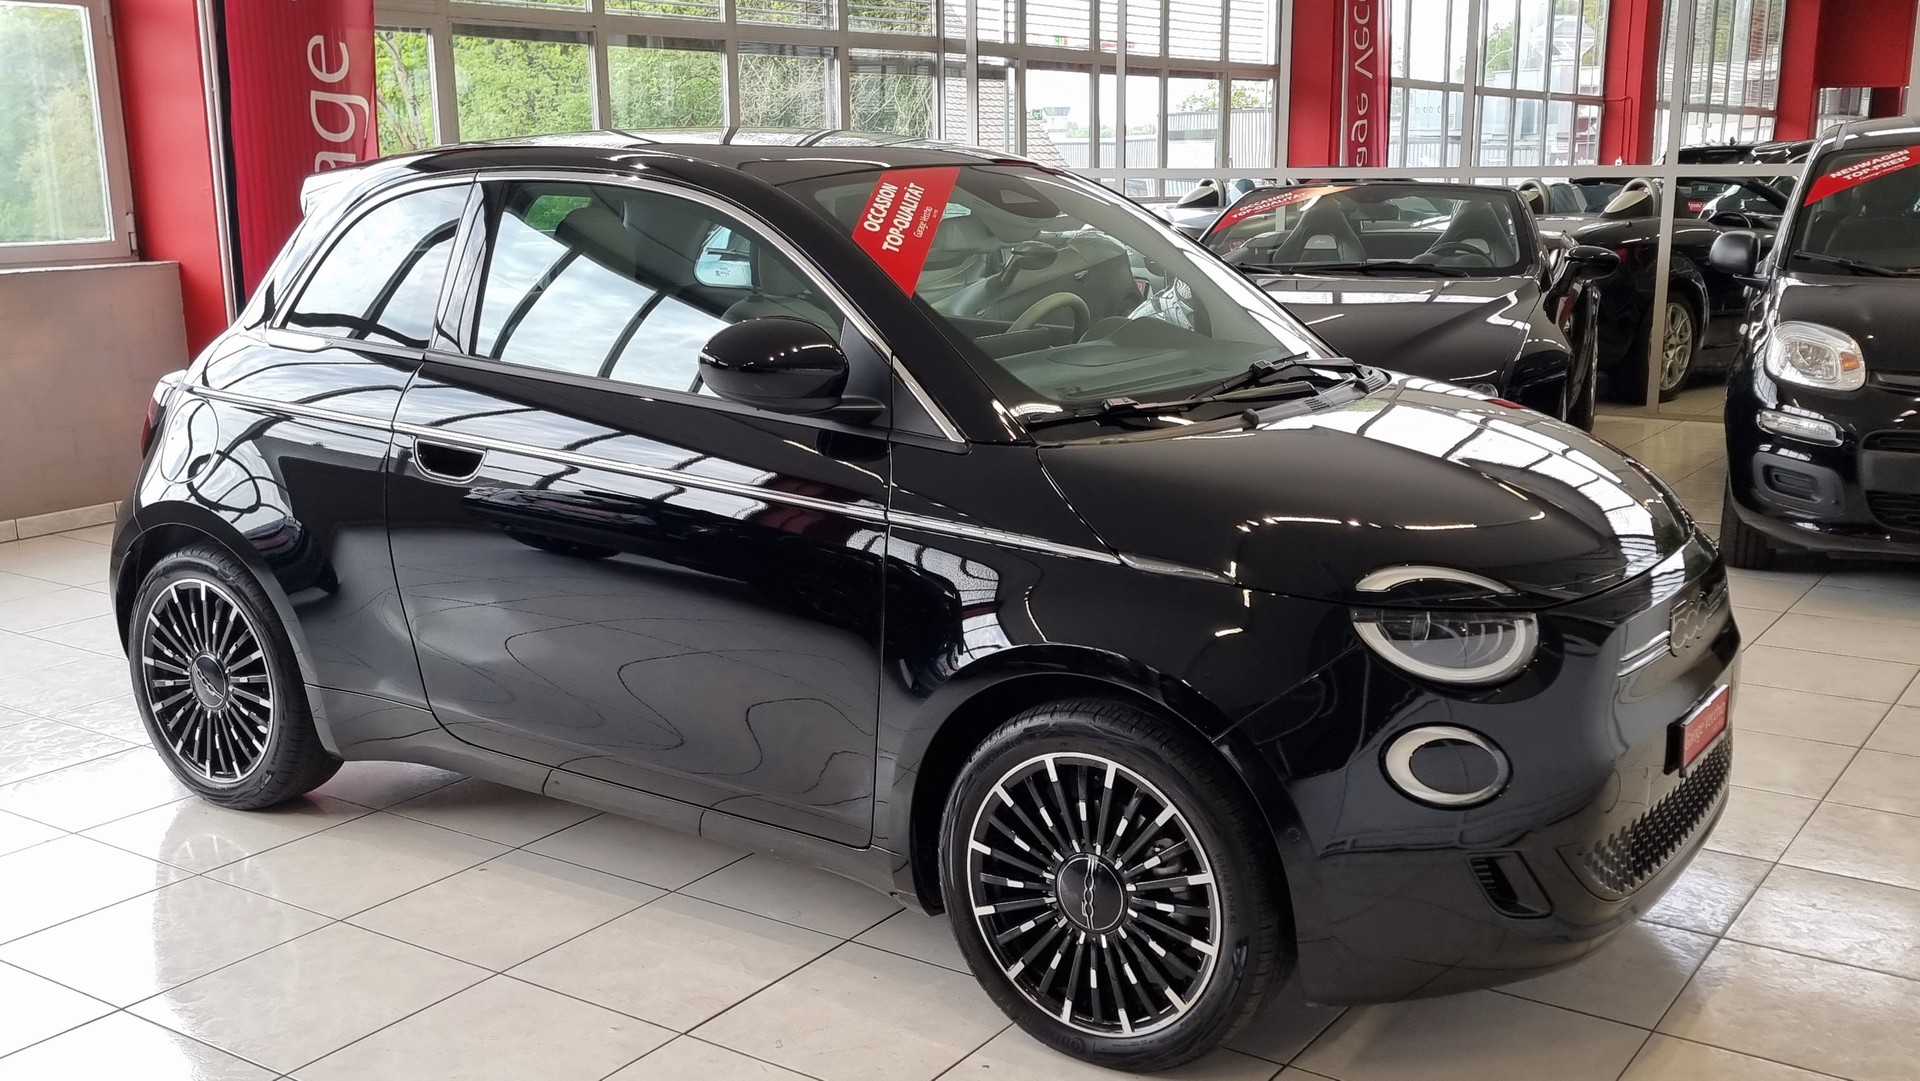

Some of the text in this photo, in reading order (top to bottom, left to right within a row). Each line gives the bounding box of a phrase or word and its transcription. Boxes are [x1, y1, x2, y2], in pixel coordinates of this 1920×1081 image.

[1829, 149, 1910, 178] NEUWAGEN
[1843, 155, 1910, 180] TOP-PREIS
[863, 182, 899, 232] OCCASION
[1239, 192, 1293, 211] OCCASION
[882, 182, 925, 252] TOP-QUALITÄT
[913, 217, 929, 238] Garage
